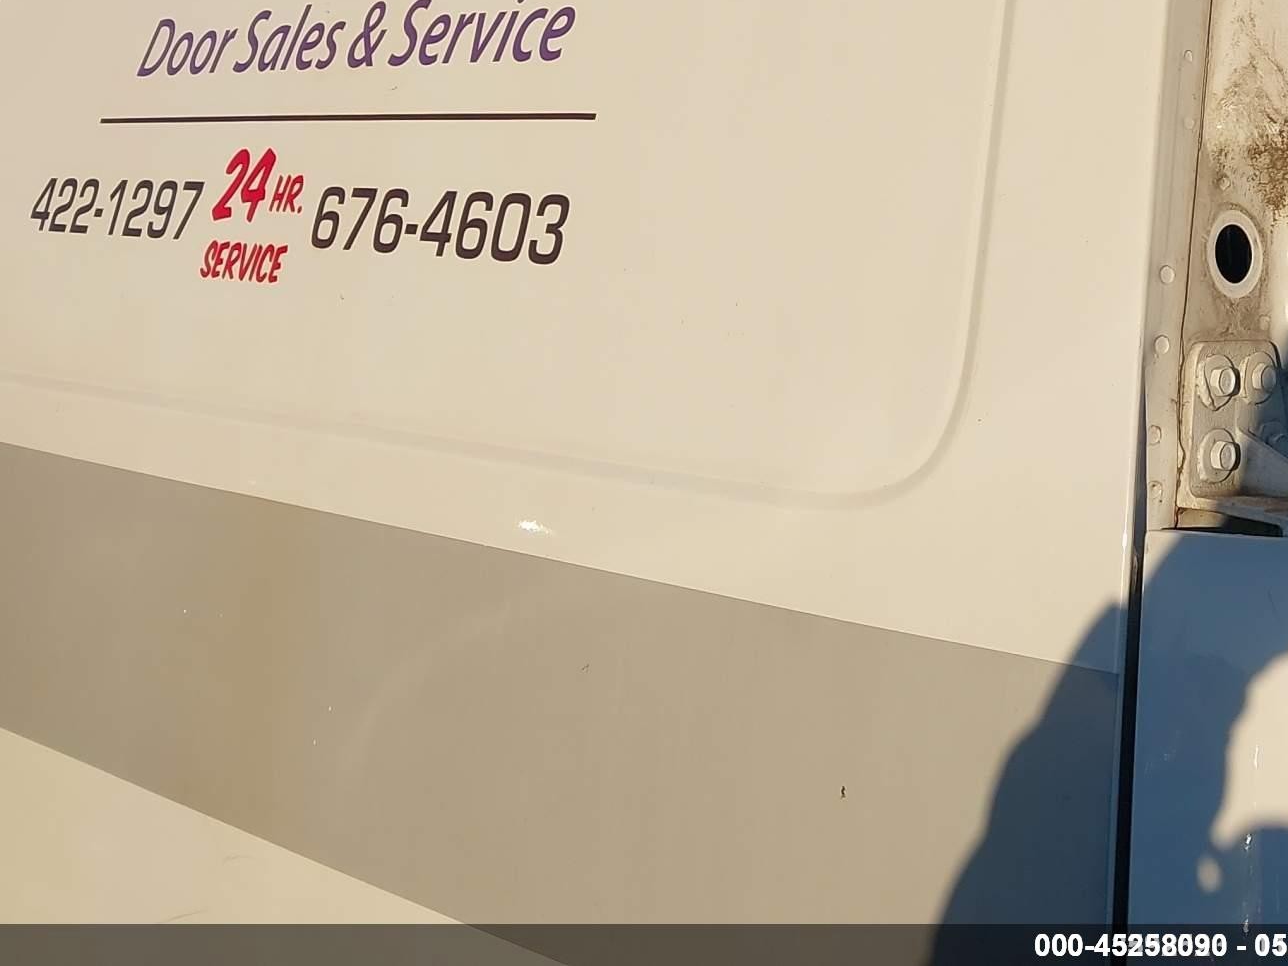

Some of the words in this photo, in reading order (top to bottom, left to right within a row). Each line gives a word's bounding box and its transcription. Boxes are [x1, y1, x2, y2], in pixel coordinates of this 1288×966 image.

[136, 17, 237, 78] Door
[232, 4, 346, 77] Sales
[347, 0, 389, 69] &
[30, 177, 205, 241] 422-1297
[211, 147, 277, 223] 24
[268, 173, 304, 215] HR.
[199, 240, 289, 284] SERVICE
[310, 186, 572, 266] 676-4603
